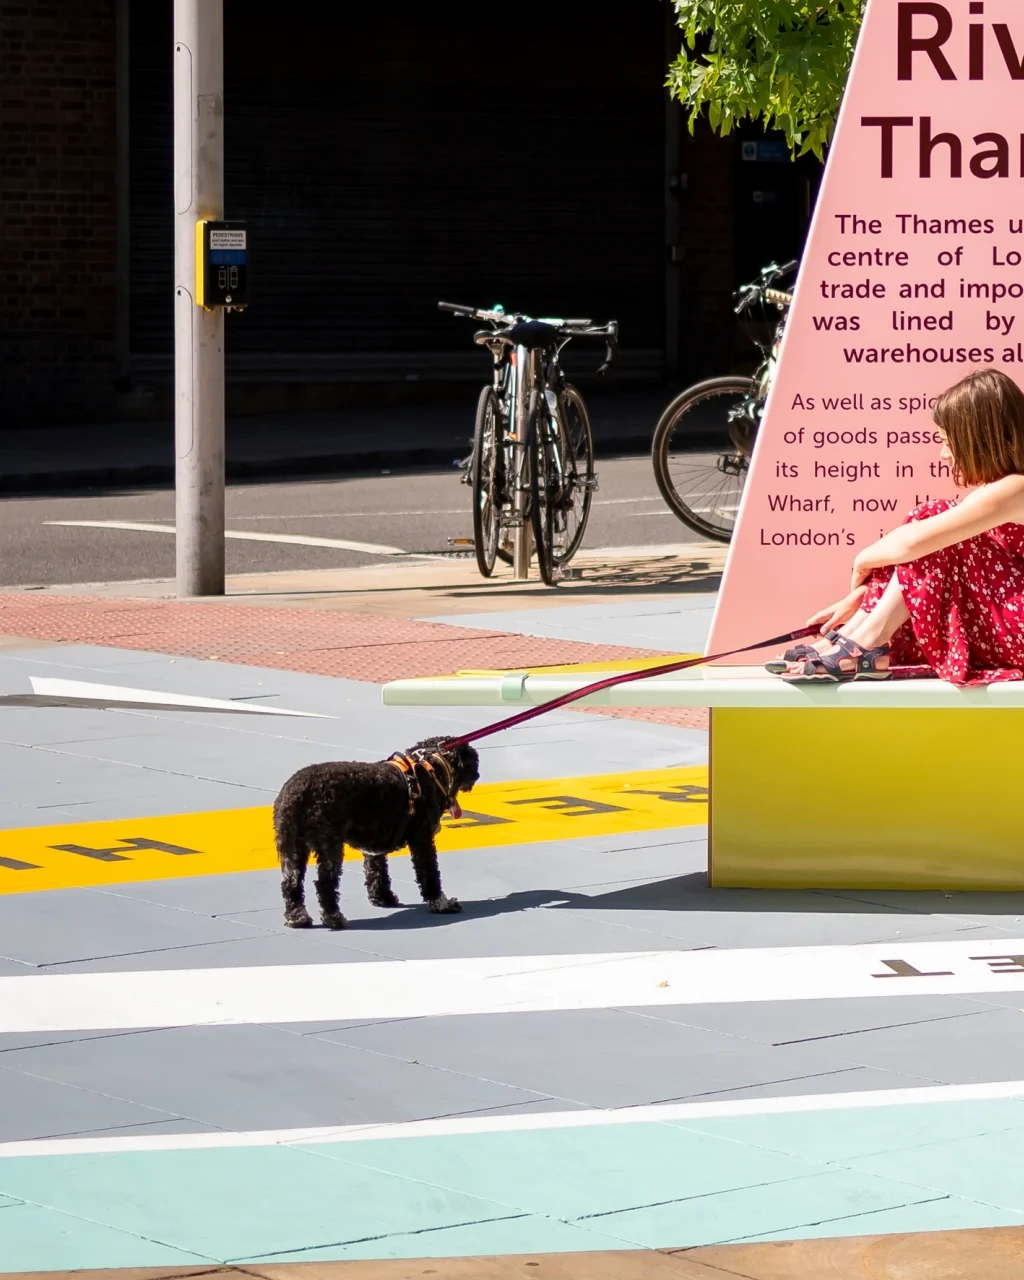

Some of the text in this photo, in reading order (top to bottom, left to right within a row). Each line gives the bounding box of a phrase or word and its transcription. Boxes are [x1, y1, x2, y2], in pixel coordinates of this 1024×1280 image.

[834, 214, 882, 235] The
[895, 214, 995, 234] Thames
[827, 247, 909, 267] centre
[937, 245, 964, 266] of
[819, 278, 886, 299] trade
[899, 278, 945, 299] and
[812, 315, 861, 331] was
[892, 310, 953, 331] lined
[986, 310, 1016, 336] by
[843, 342, 995, 364] warehouses
[791, 393, 815, 411] As
[821, 393, 864, 411] well
[870, 397, 892, 411] as
[898, 393, 938, 414] spic
[783, 426, 805, 444] of
[813, 427, 878, 449] goods
[886, 431, 943, 448] passe
[776, 460, 799, 478] its
[814, 460, 881, 483] height
[896, 460, 914, 478] in
[929, 460, 957, 478] th
[767, 494, 835, 514] Wharf,
[853, 498, 898, 512] now
[760, 528, 855, 546] London's
